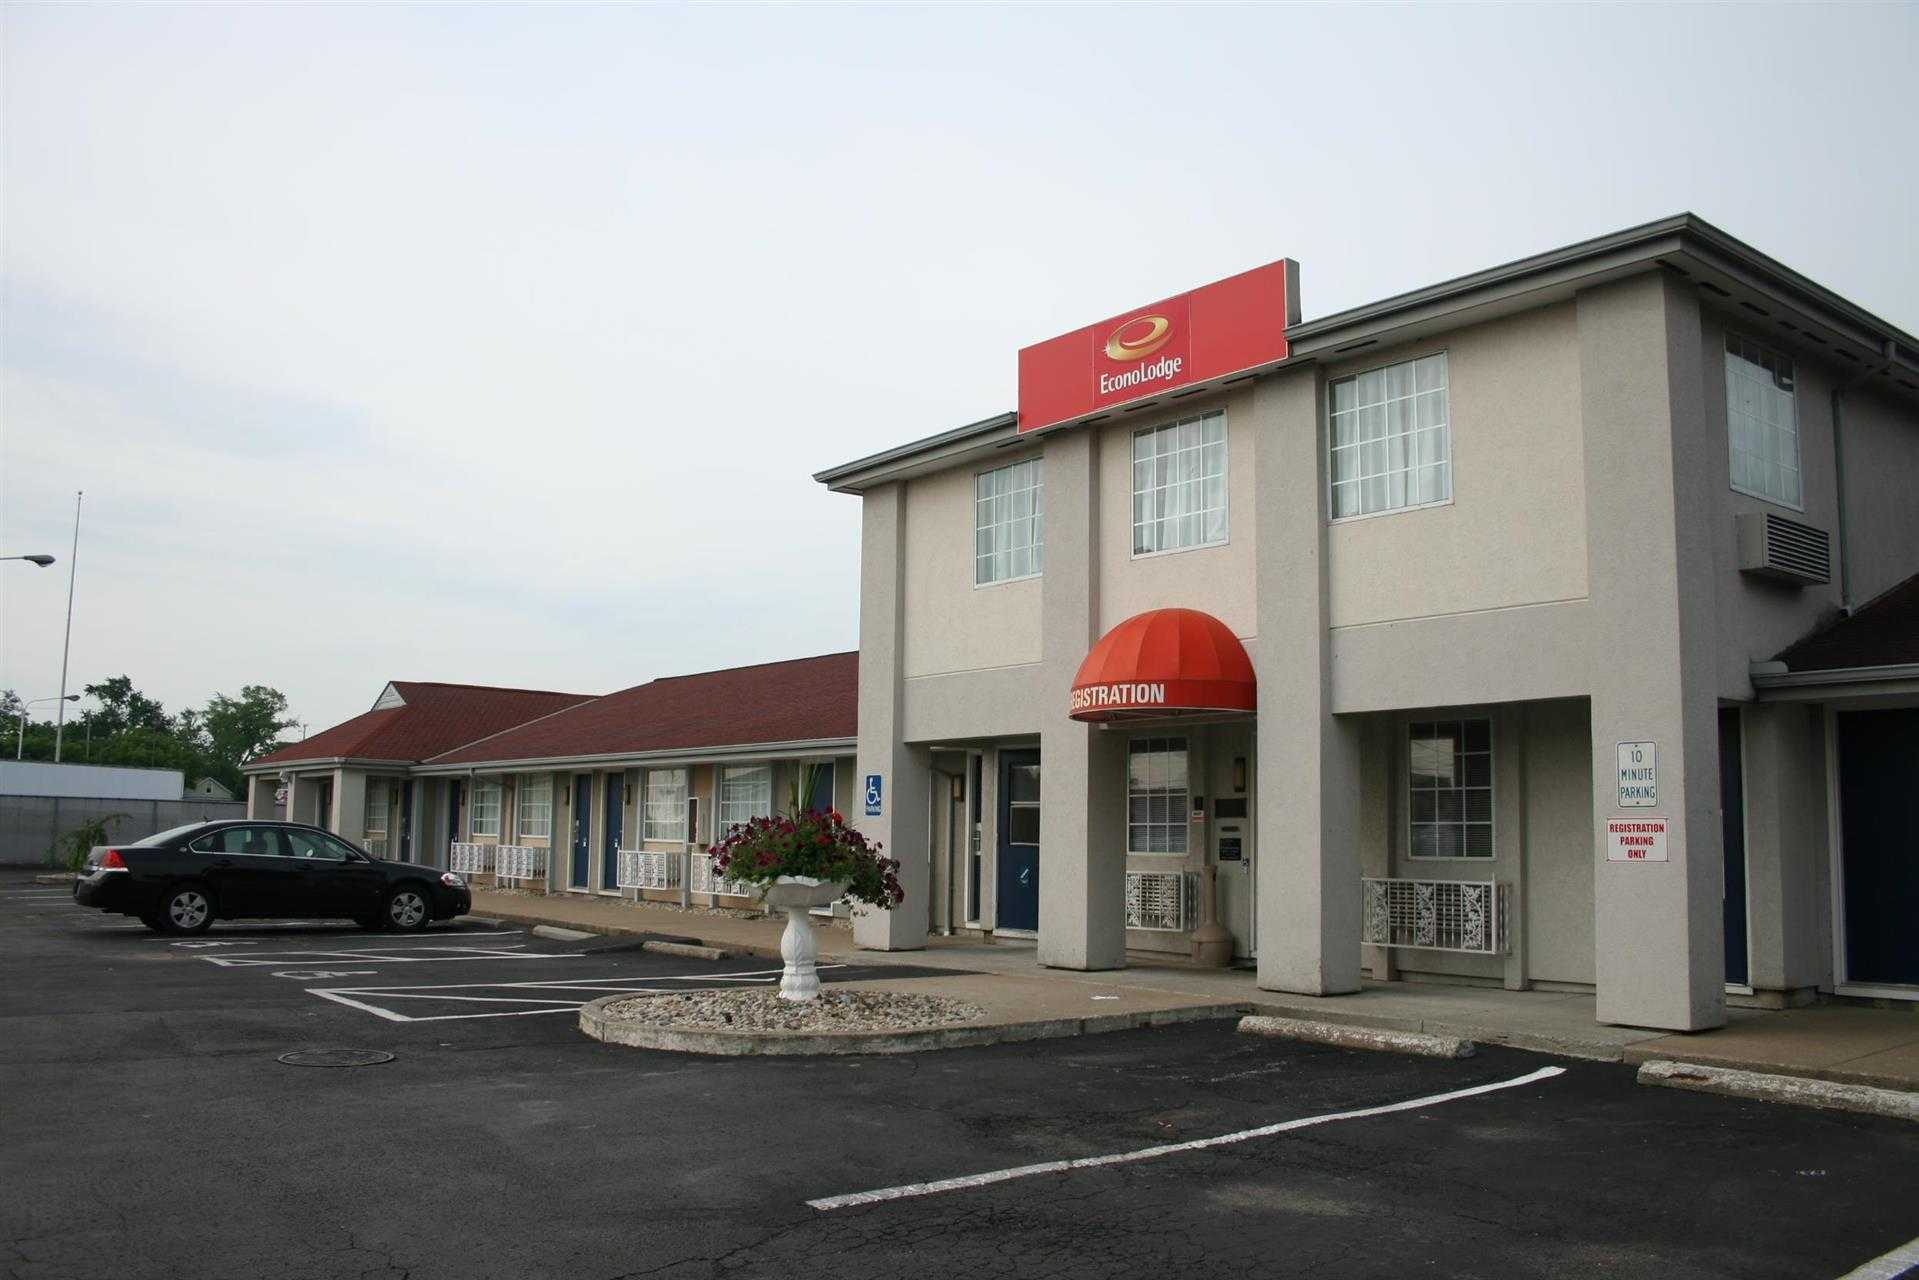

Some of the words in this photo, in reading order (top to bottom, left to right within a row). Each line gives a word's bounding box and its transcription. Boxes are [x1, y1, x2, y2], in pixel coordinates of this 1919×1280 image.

[1071, 683, 1165, 709] EGISTRATION
[1631, 750, 1643, 763] 10
[1621, 768, 1654, 781] MINUTE
[1620, 786, 1656, 799] PARKING
[1609, 823, 1665, 833] REGISTRATION
[1620, 836, 1654, 846] PARKING
[1627, 849, 1647, 859] ONLY
